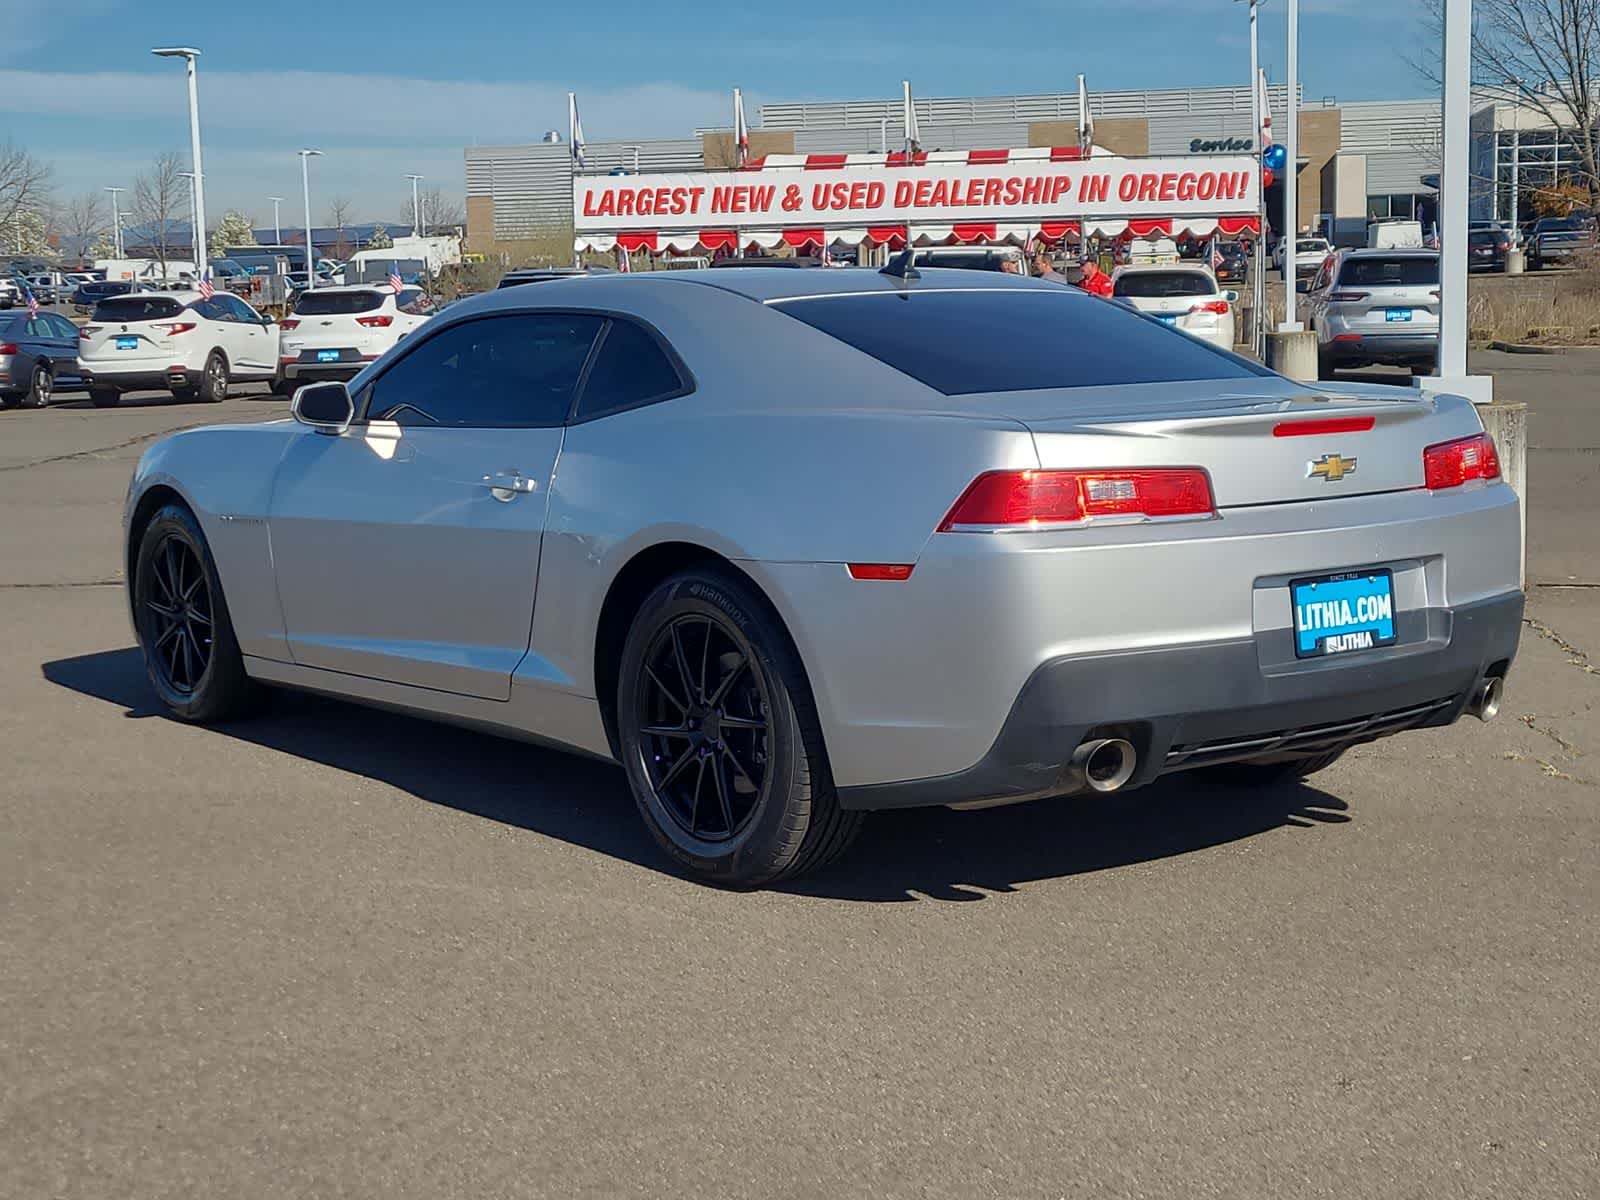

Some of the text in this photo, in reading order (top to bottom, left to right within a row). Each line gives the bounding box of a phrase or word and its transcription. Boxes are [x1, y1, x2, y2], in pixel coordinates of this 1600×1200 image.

[1189, 137, 1254, 154] Service
[582, 171, 1249, 216] LARGEST NEW & USED DEALERSHIP IN OREGON!
[1298, 593, 1391, 631] LITHIA.COM
[1338, 631, 1373, 648] LITHIA
